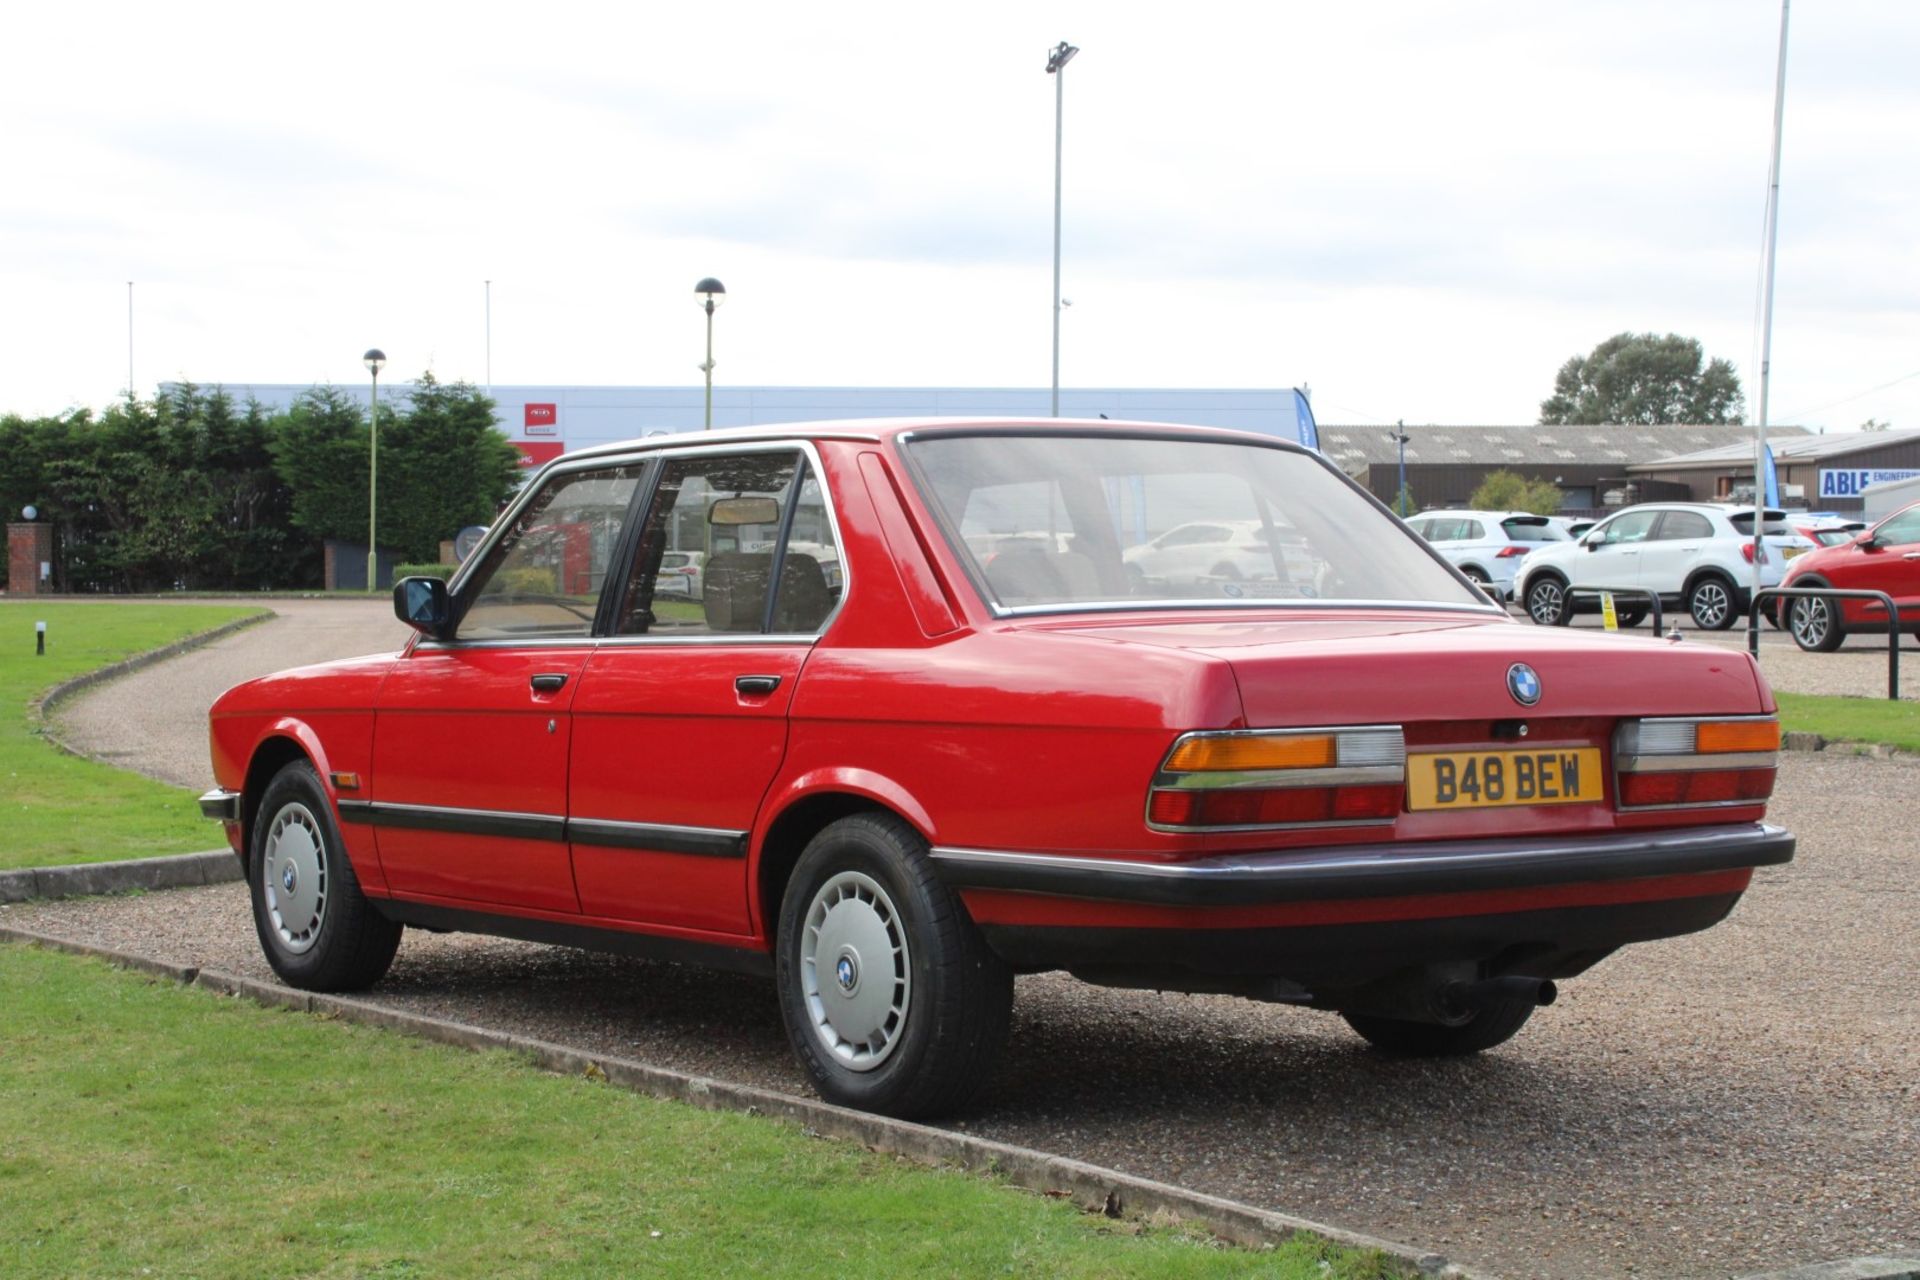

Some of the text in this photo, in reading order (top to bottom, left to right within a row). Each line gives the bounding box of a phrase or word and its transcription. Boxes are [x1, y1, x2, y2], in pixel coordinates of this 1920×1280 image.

[1824, 472, 1920, 495] ABLE ENGINEERI
[1434, 753, 1580, 803] B48 BEW
